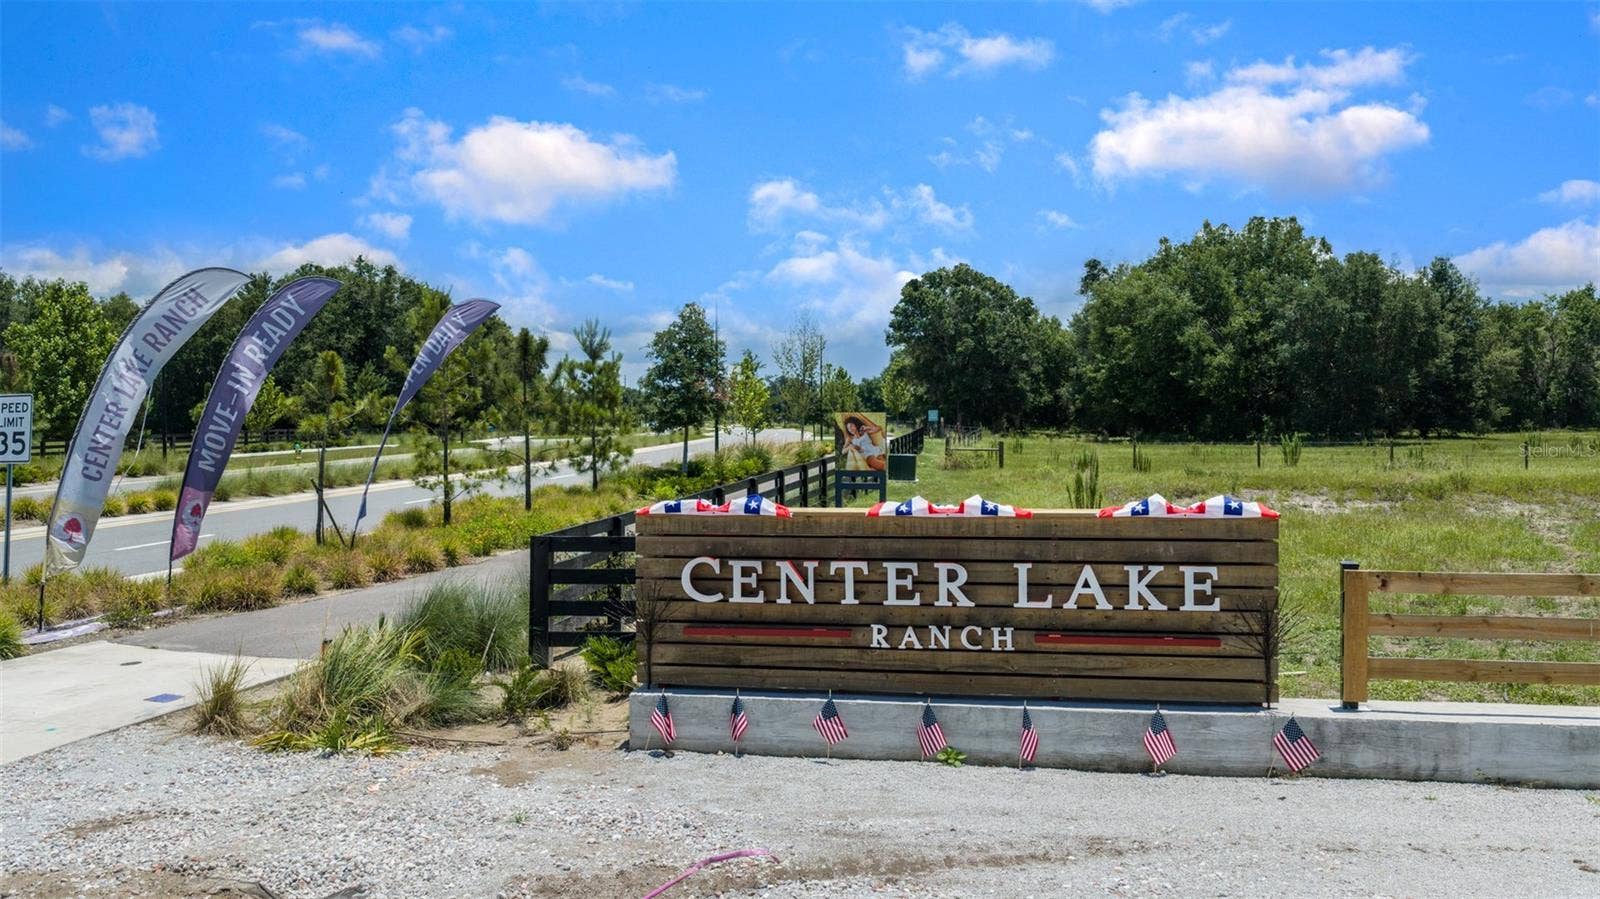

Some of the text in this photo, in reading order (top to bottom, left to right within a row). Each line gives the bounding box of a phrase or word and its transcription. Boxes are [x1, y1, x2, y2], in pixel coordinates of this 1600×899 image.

[424, 312, 467, 355] DAILY
[81, 287, 210, 482] CENTER LAKE RANCH
[198, 294, 306, 472] MOVE-IN READY
[0, 402, 29, 414] PEED
[0, 431, 26, 456] 35
[681, 556, 1221, 612] CENTER LAKE
[869, 623, 1016, 651] RANCH
